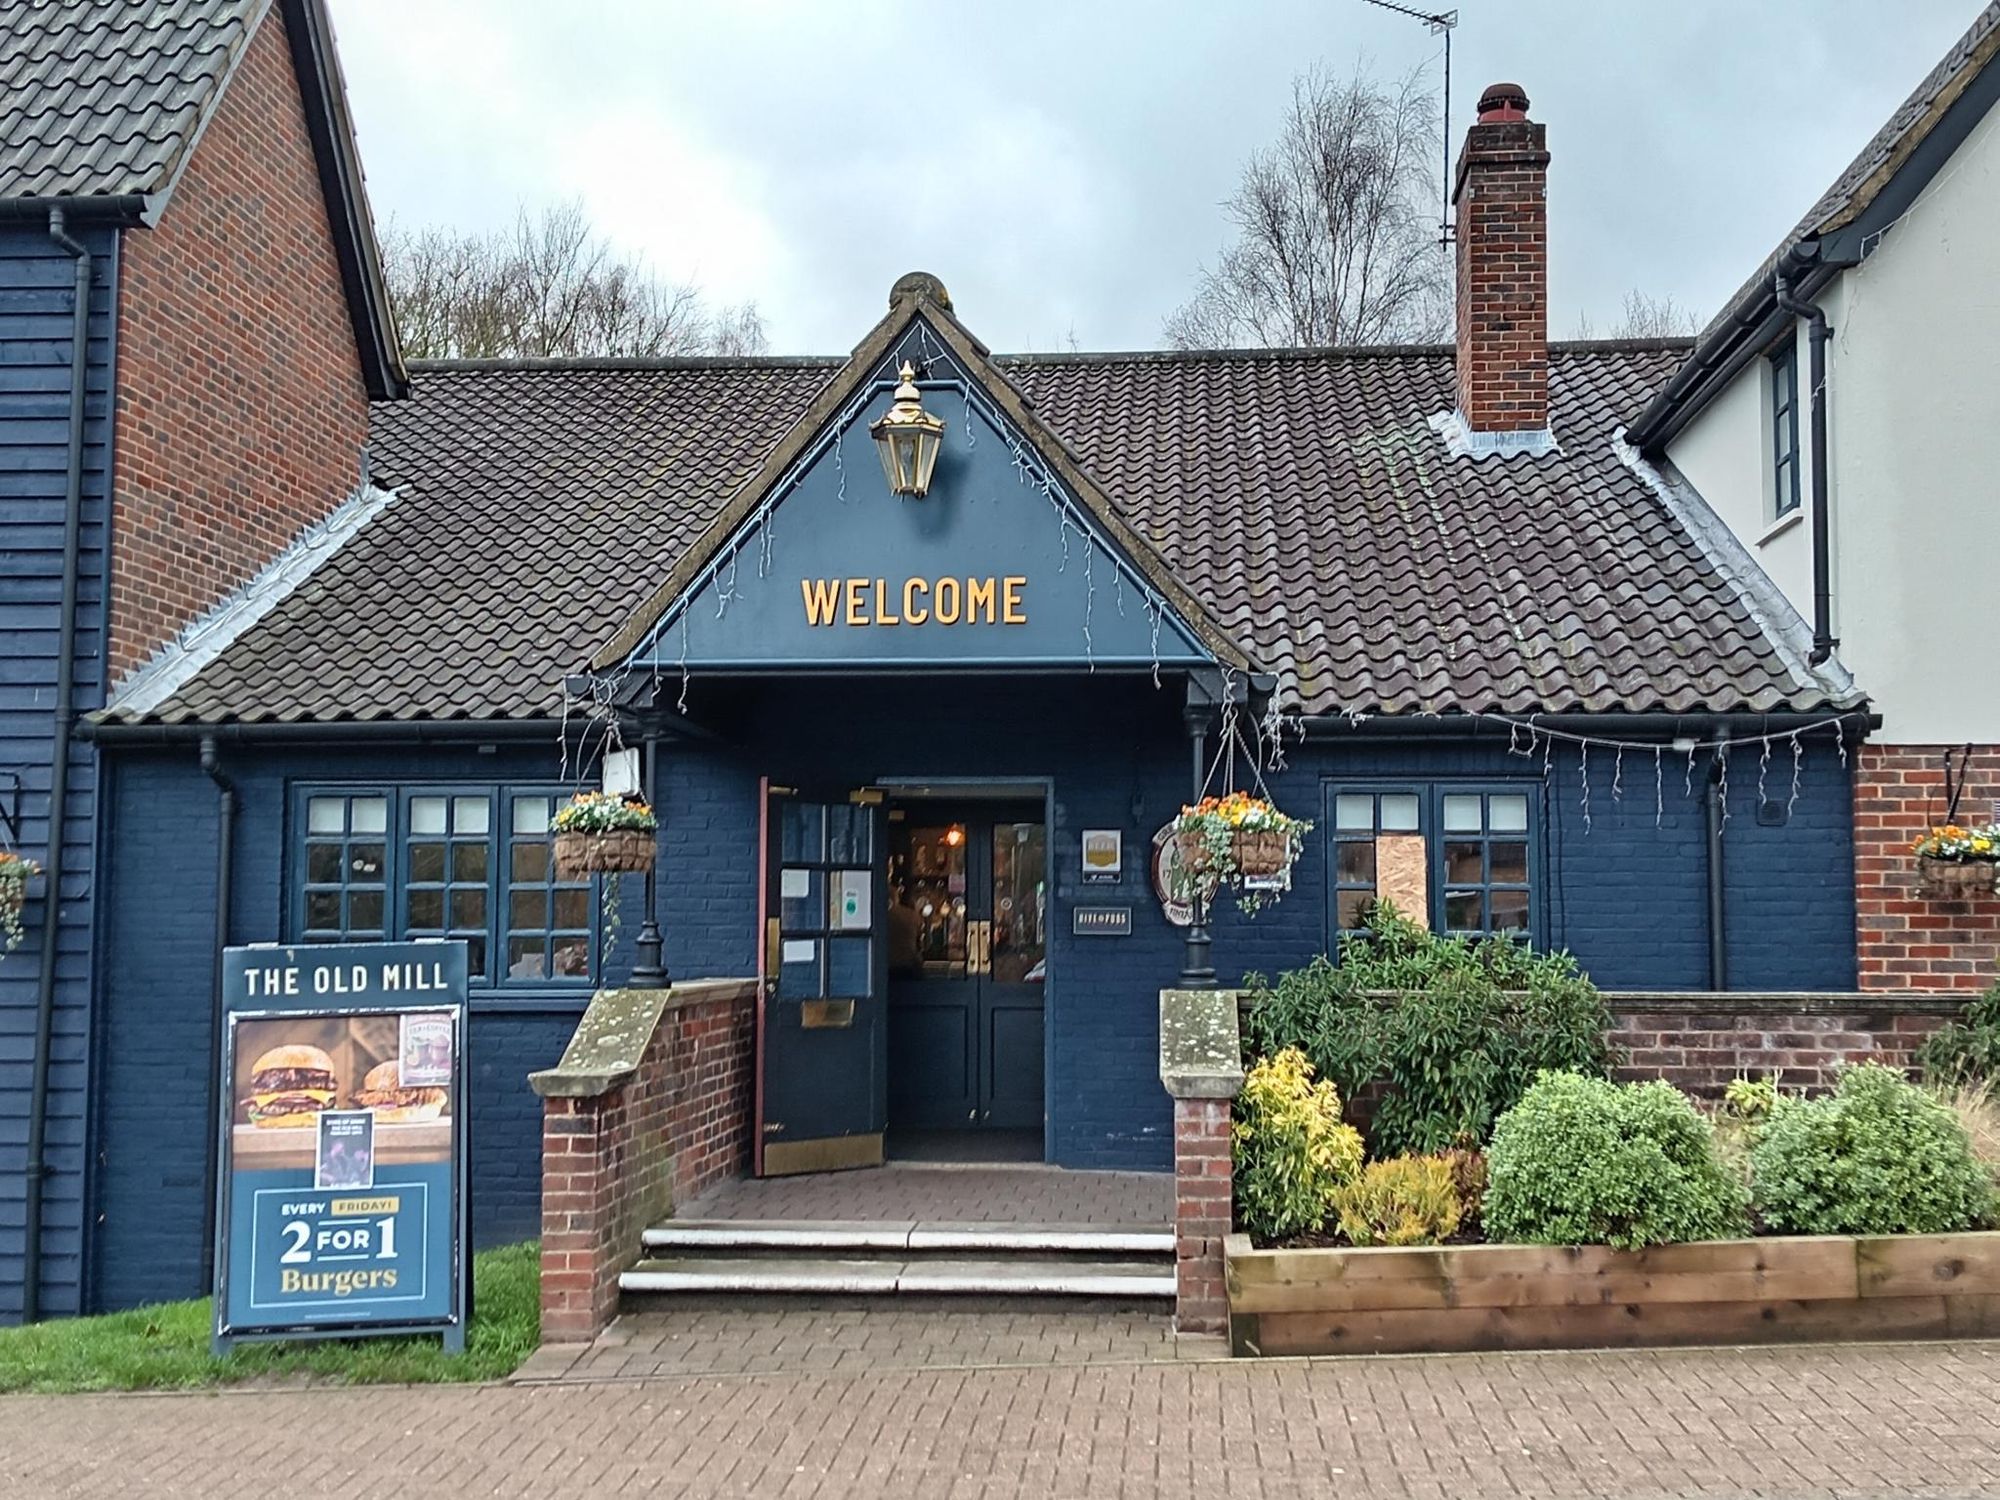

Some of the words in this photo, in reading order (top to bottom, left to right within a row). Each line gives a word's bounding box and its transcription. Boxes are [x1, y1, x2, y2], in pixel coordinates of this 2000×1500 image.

[802, 576, 1027, 625] WELCOME
[244, 967, 300, 996] THE
[314, 966, 367, 993] OLD
[382, 962, 448, 991] MILL
[281, 1202, 326, 1216] EVERY
[338, 1201, 393, 1212] FRIDAY!
[280, 1220, 312, 1264] 2
[316, 1229, 371, 1251] FOR
[375, 1216, 399, 1260] 1
[280, 1268, 398, 1297] Burgers
